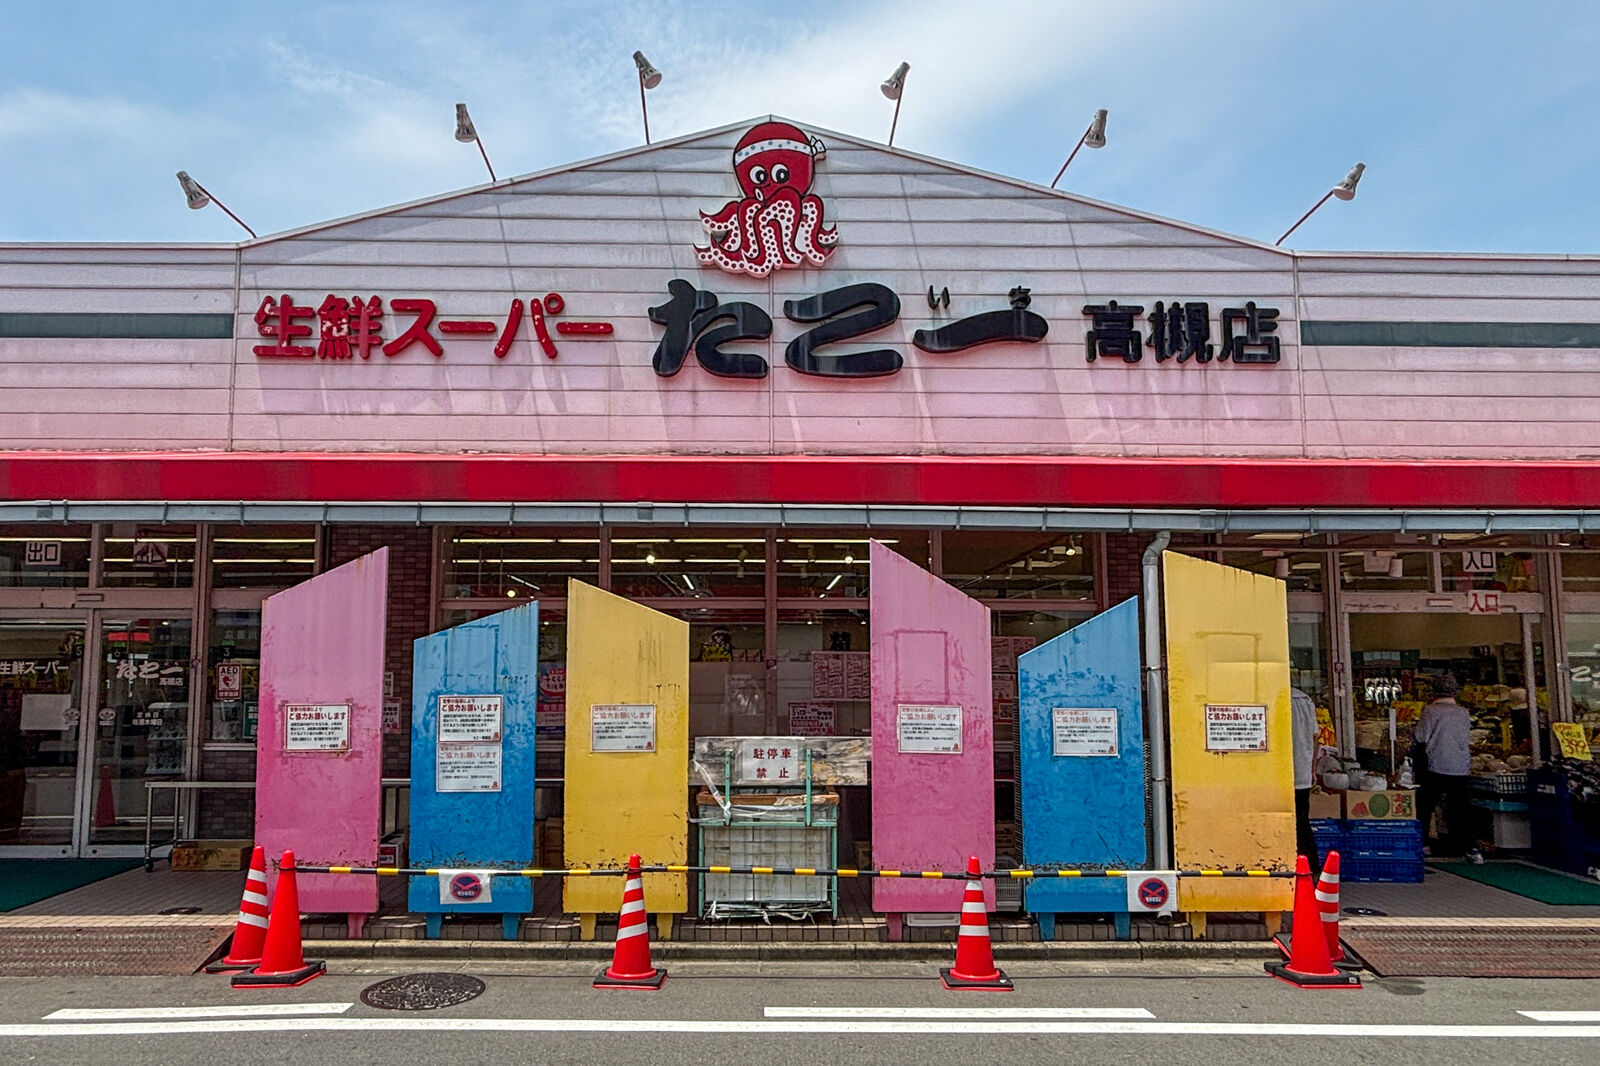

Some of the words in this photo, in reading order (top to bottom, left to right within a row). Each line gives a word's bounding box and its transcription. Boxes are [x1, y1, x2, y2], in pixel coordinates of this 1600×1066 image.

[253, 293, 613, 359] 生鮮スーパー
[648, 278, 1048, 378] たこ一
[1082, 300, 1281, 364] 高槻店
[28, 543, 58, 562] 出口
[1465, 551, 1493, 570] 入口
[1470, 592, 1499, 612] 入口
[0, 661, 69, 674] 生鮮スーパー
[221, 667, 238, 675] AED
[441, 704, 499, 712] ご協力お願いします
[289, 712, 346, 720] ご協力お願いします
[1208, 713, 1264, 721] ご協力お願いします
[753, 748, 792, 759] 駐停車
[756, 767, 789, 779] 禁止
